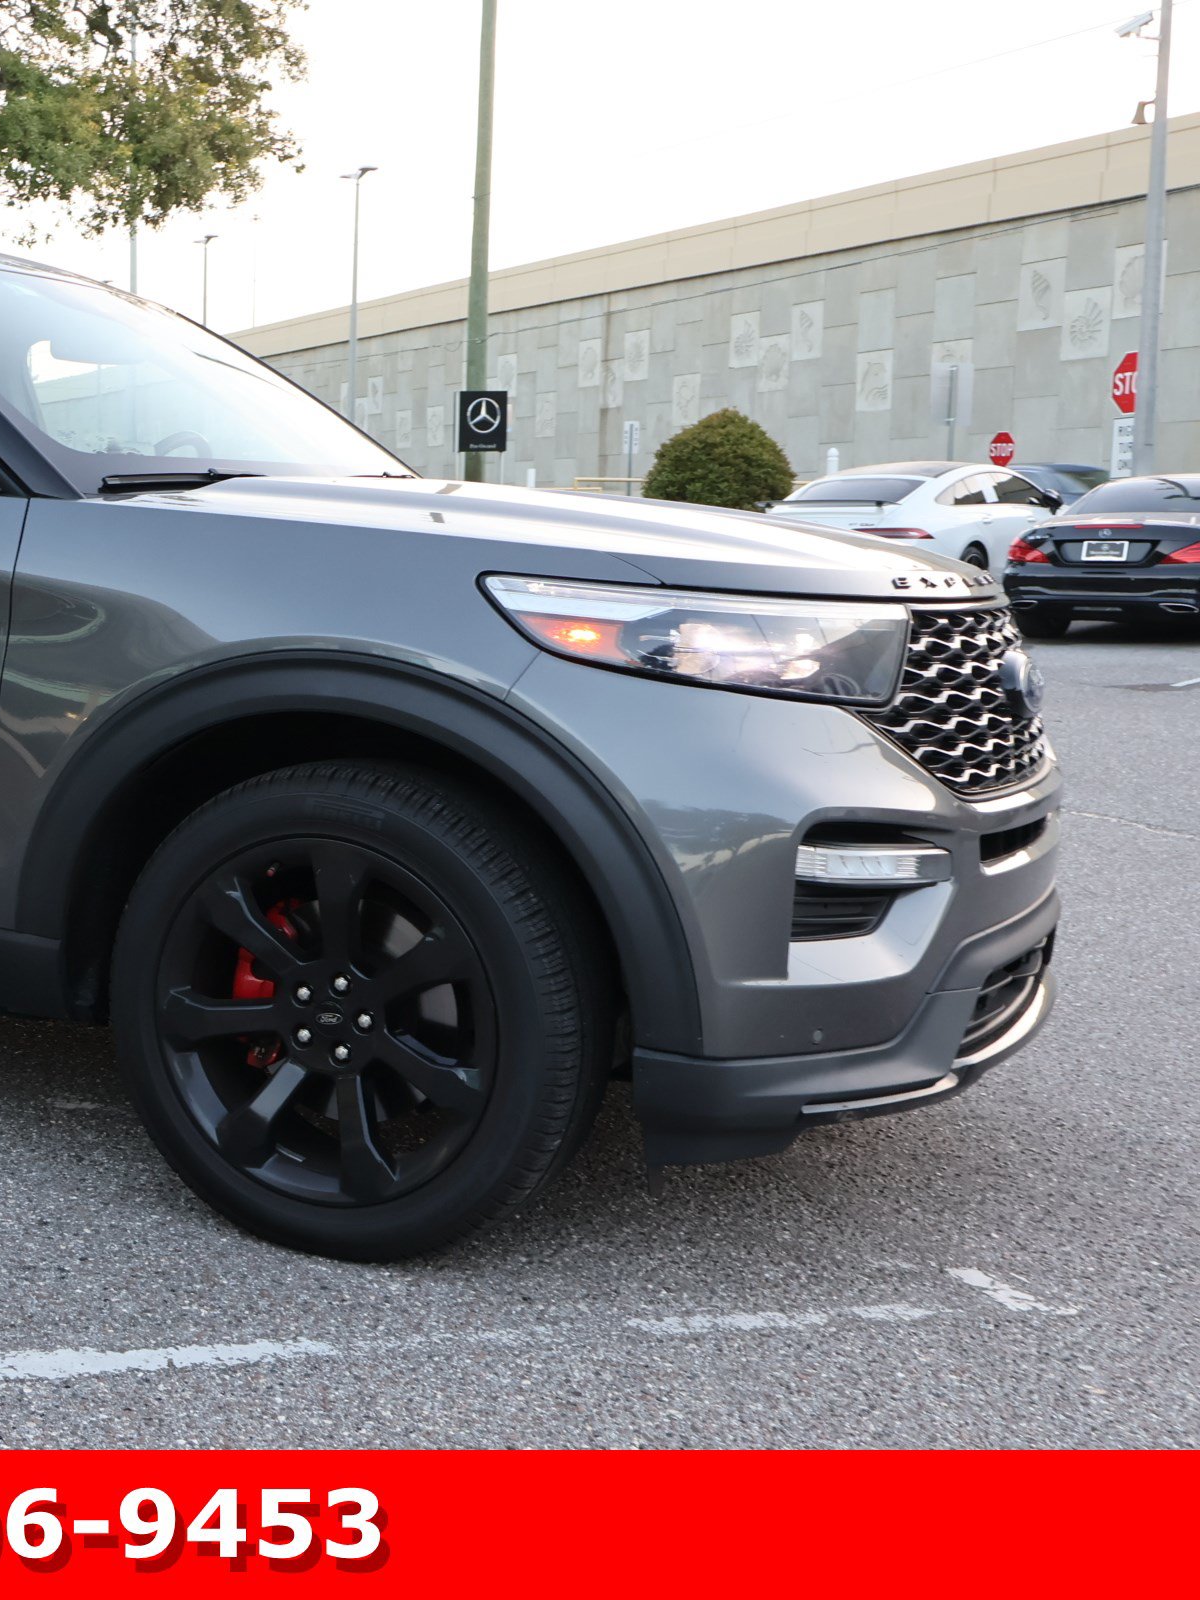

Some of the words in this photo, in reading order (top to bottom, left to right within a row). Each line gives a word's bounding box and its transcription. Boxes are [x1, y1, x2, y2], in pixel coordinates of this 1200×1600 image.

[1113, 371, 1137, 396] STO
[990, 443, 1013, 456] STOP
[319, 1014, 338, 1023] Ford
